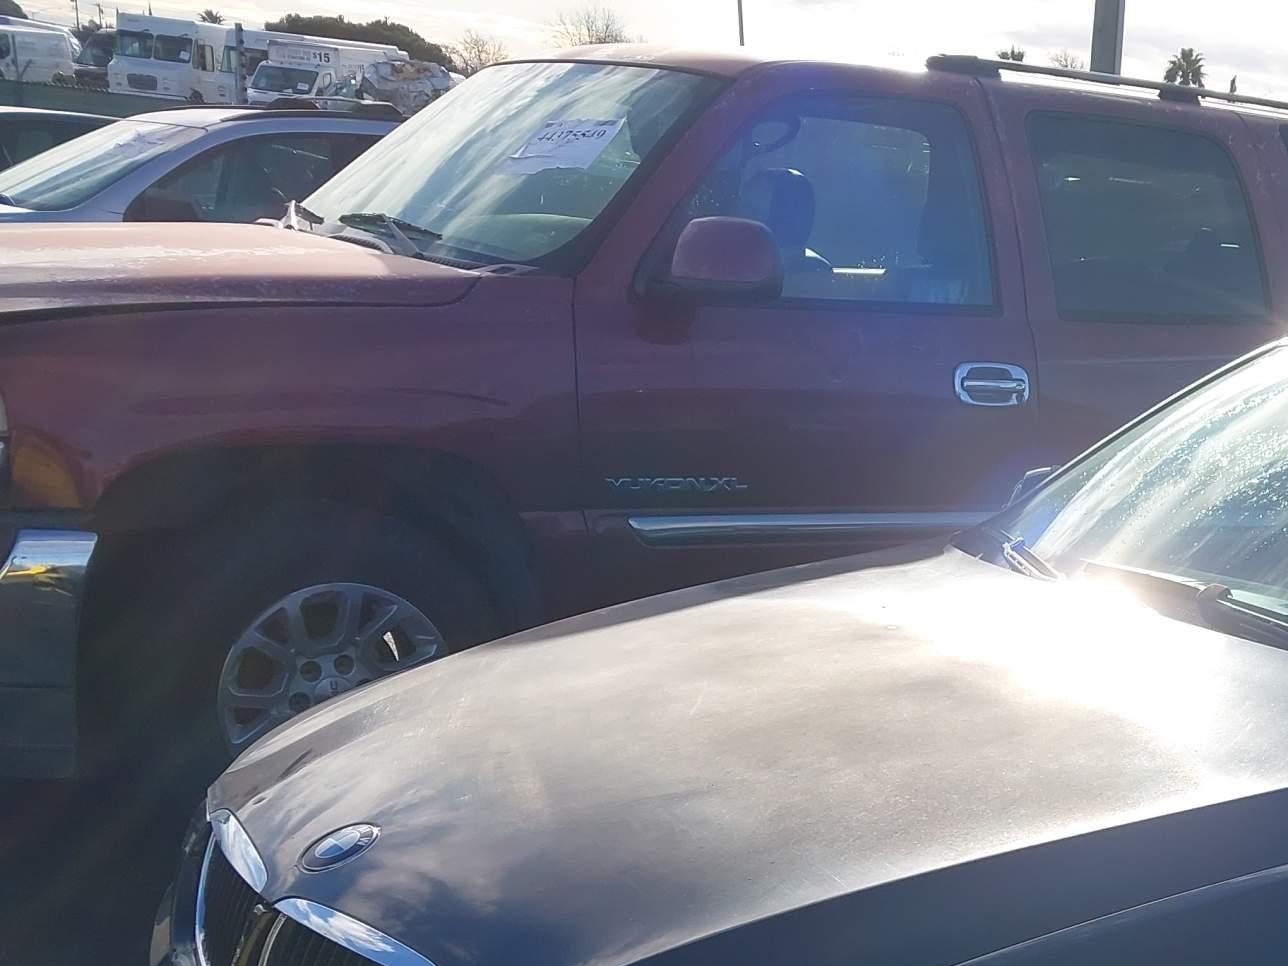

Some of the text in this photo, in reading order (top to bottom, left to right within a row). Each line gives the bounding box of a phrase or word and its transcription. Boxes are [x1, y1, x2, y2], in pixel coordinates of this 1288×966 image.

[312, 52, 331, 63] $15
[605, 477, 748, 491] YUKON XL
